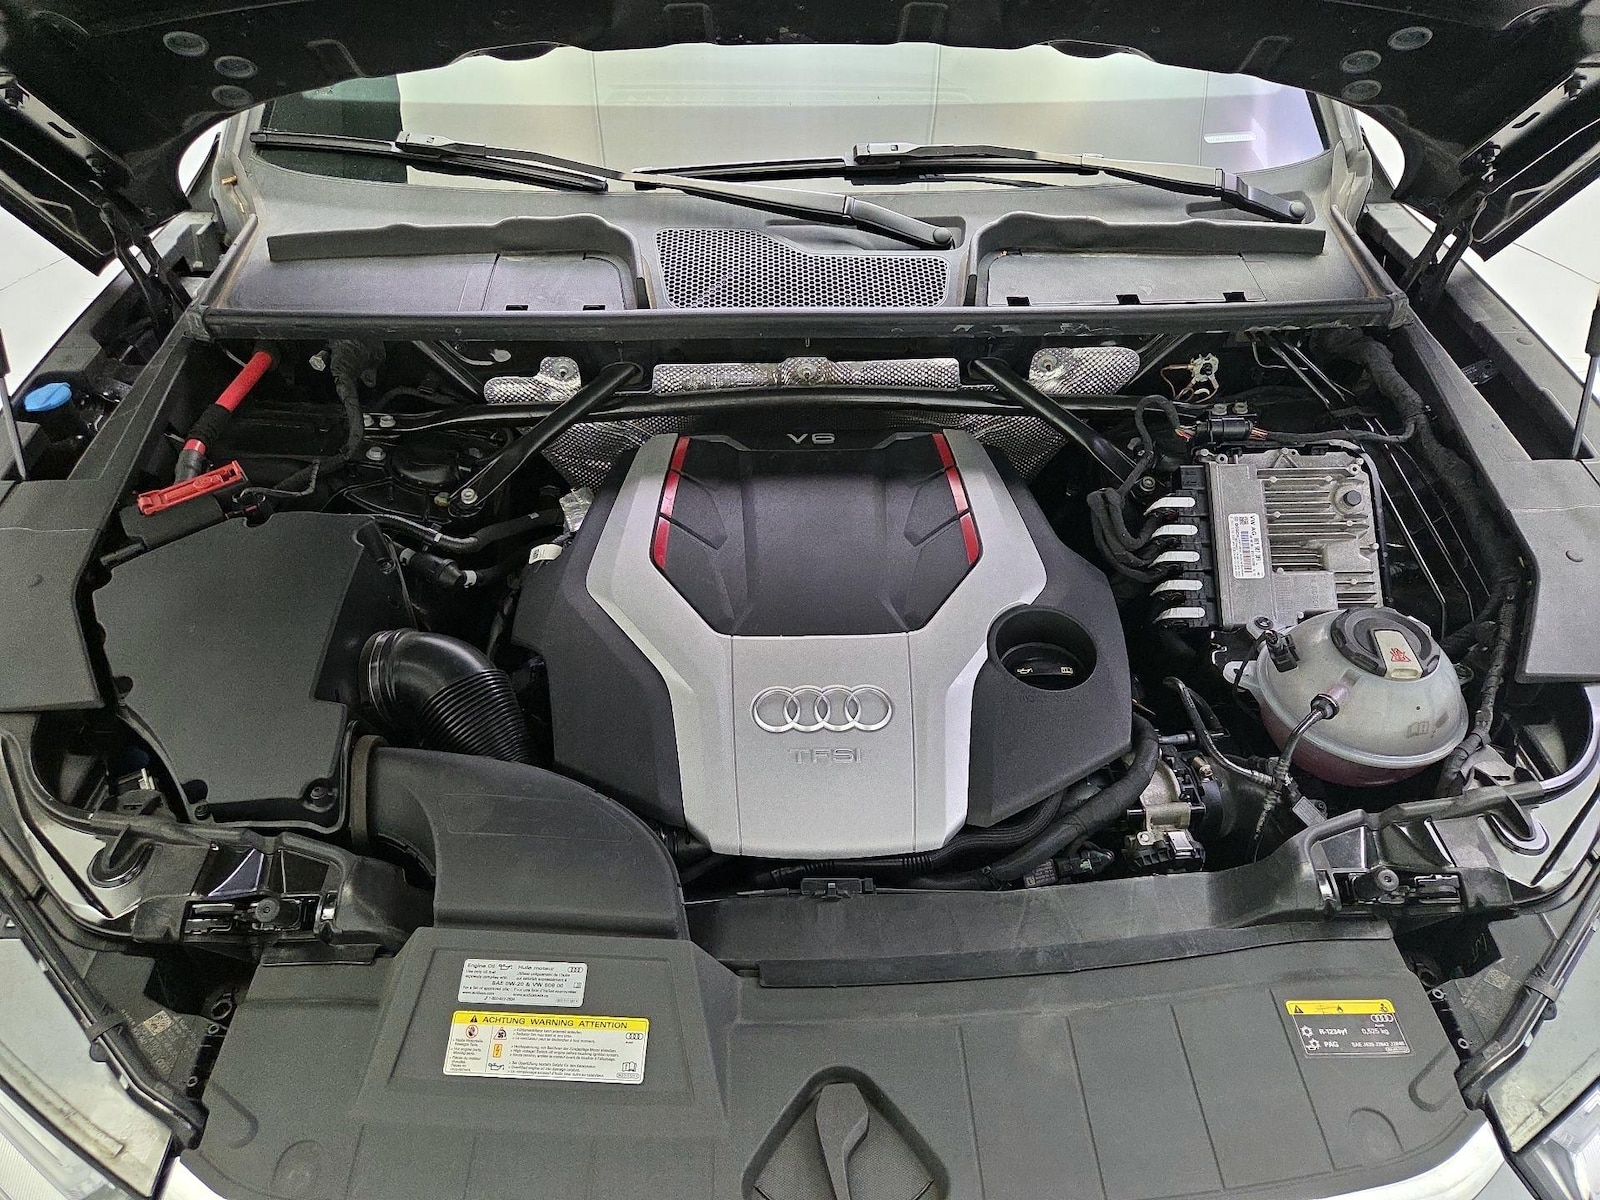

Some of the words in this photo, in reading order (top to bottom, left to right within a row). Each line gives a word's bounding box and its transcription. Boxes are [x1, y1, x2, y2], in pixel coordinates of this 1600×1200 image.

[787, 433, 835, 444] V6
[1250, 515, 1256, 525] VW
[1251, 526, 1257, 536] AG
[787, 747, 861, 763] TFSI
[482, 1016, 525, 1025] ACHTUNG
[530, 1018, 574, 1027] WARNING
[578, 1020, 628, 1029] ATTENTION
[1319, 1028, 1348, 1036] R-1234yf
